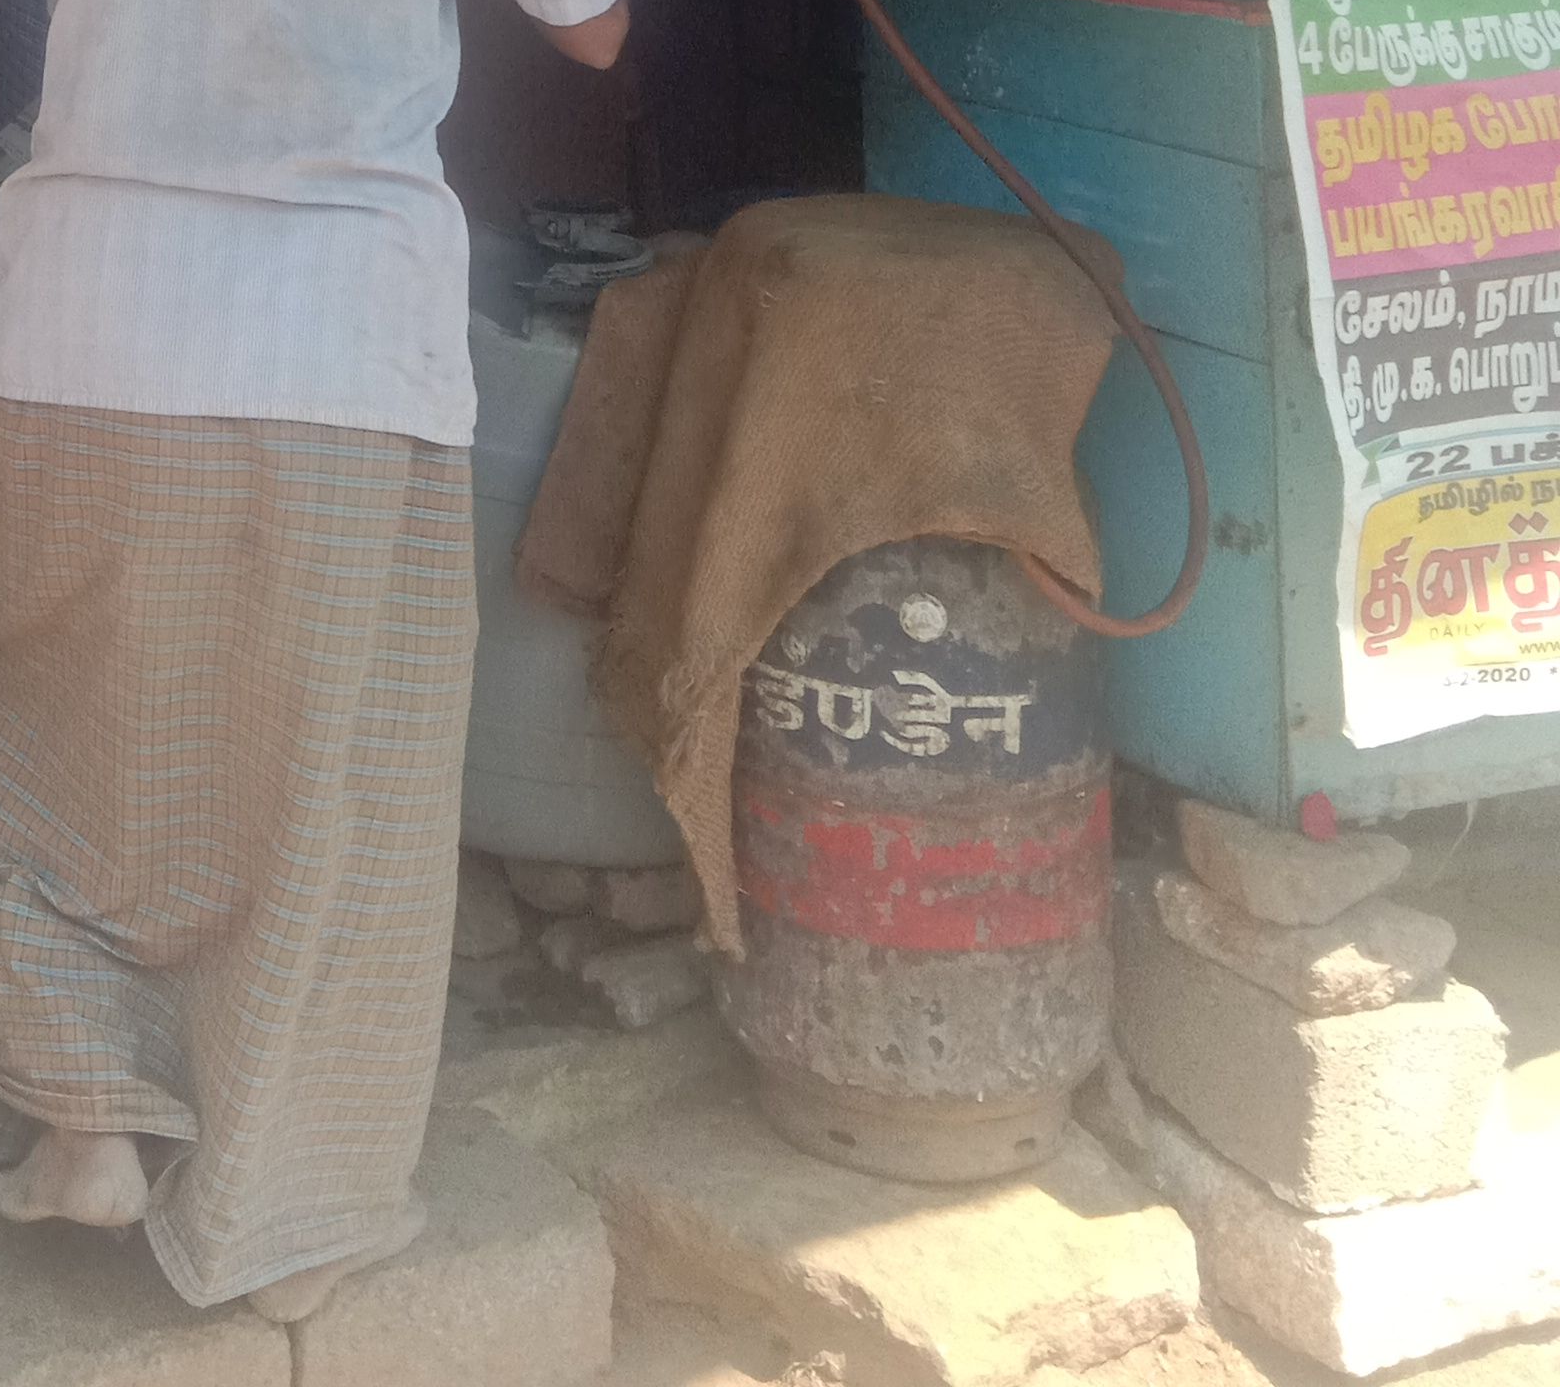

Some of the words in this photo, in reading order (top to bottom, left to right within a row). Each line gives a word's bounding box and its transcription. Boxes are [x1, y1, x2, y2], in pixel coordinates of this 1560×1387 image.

[1298, 21, 1323, 74] 4
[1328, 4, 1468, 87] பேருக்கு
[1316, 91, 1467, 187] தமிழக
[1327, 165, 1560, 259] பயங்கரவா
[1335, 269, 1466, 344] சேலம்,
[1342, 353, 1443, 436] தி.மு.க.
[1406, 444, 1471, 481] 22
[1418, 475, 1525, 523] தமிழில்
[1430, 622, 1486, 640] DAILY
